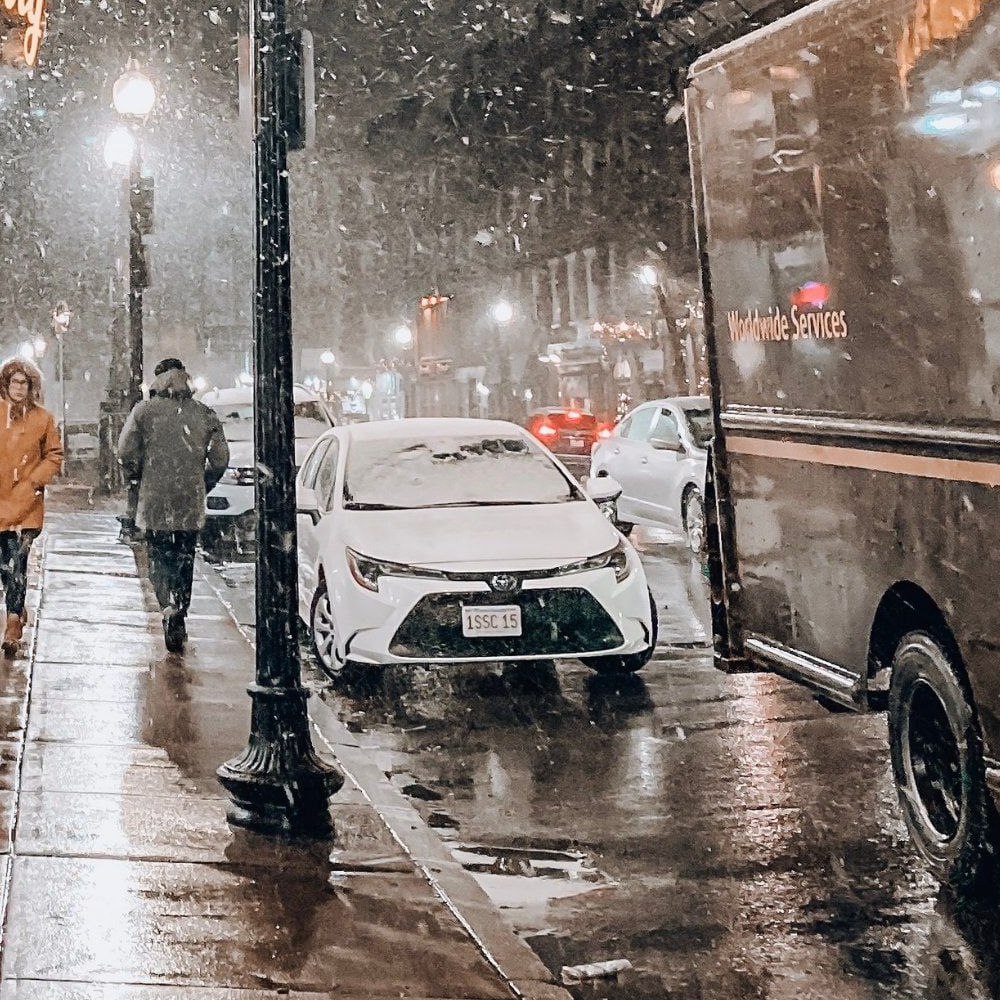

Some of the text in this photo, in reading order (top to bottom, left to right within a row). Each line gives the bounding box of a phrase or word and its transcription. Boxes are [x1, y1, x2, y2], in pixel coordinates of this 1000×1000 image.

[727, 304, 848, 341] Worldwide Services
[502, 613, 519, 629] 15
